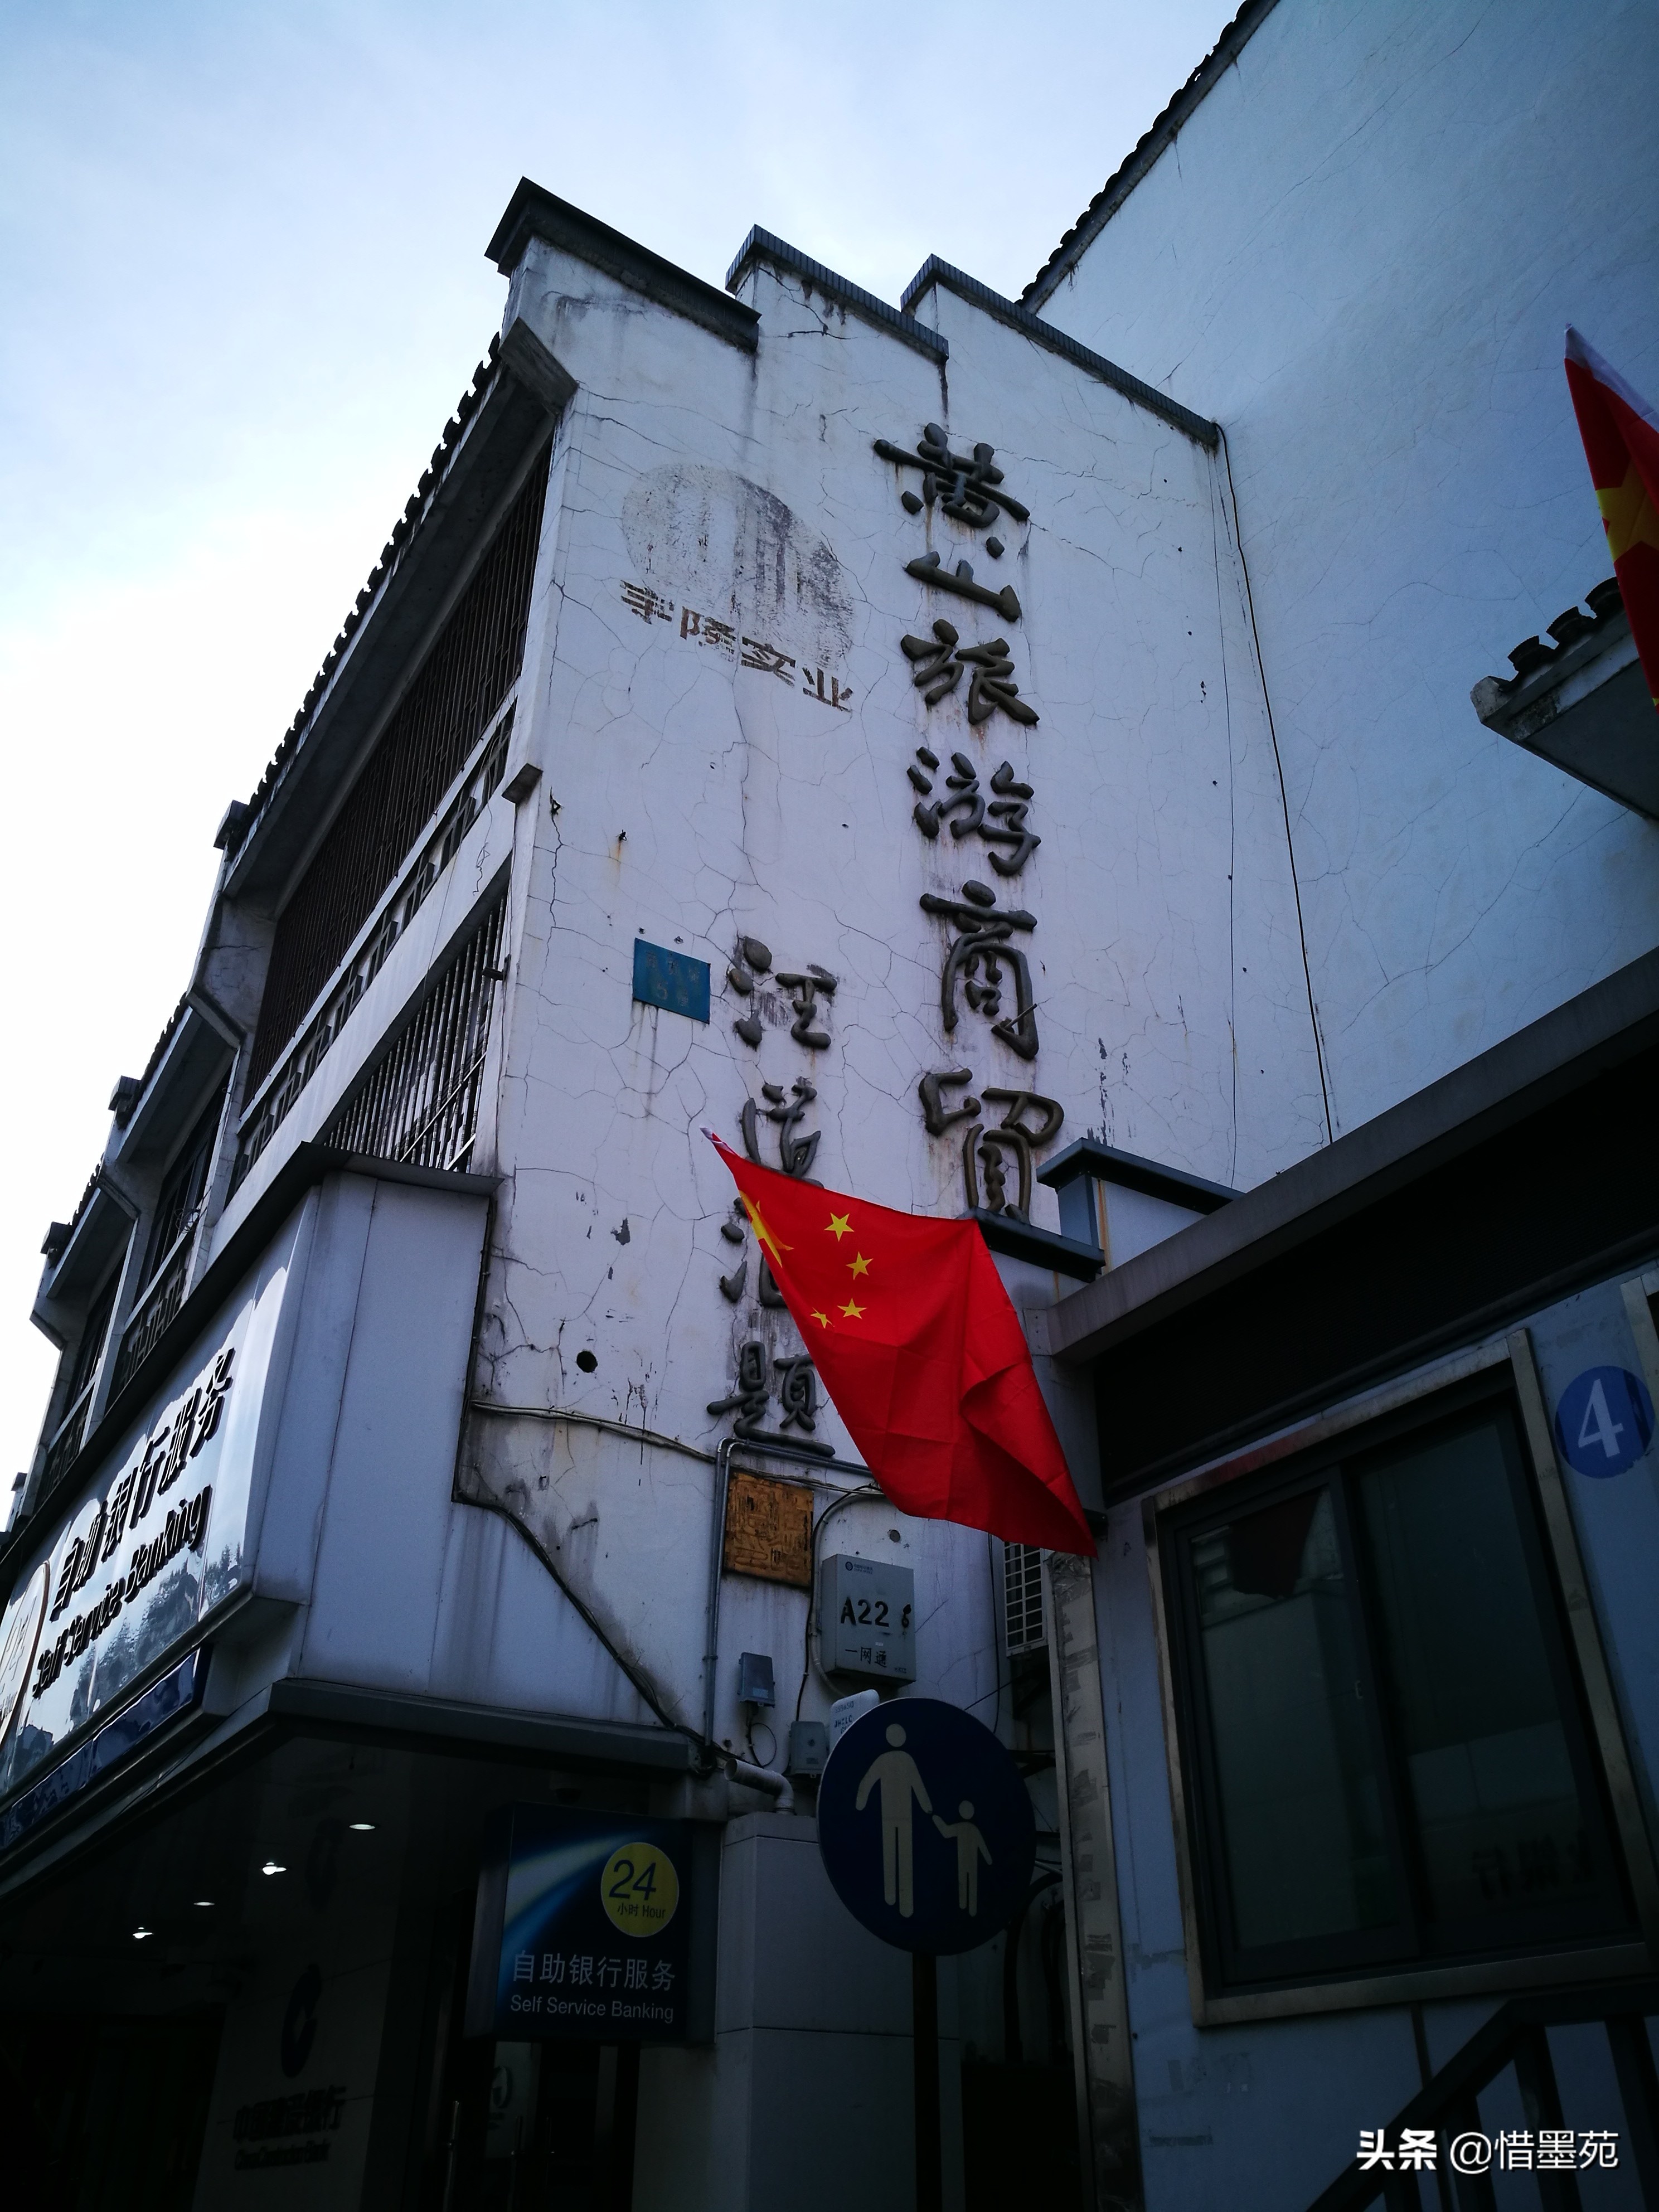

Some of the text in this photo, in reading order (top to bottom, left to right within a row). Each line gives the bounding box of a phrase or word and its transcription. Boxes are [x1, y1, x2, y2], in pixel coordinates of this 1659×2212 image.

[1578, 1379, 1624, 1458] 4
[51, 1347, 235, 1622] 自助银行服务
[32, 1484, 213, 1699] Self Service Banking
[841, 1597, 889, 1627] A22
[845, 1647, 887, 1667] 一网通
[609, 1859, 657, 1901] 24
[617, 1903, 666, 1918] 小时 Hour
[512, 1950, 676, 1991] 自助银行服务
[510, 1994, 674, 2024] Self Service Banking
